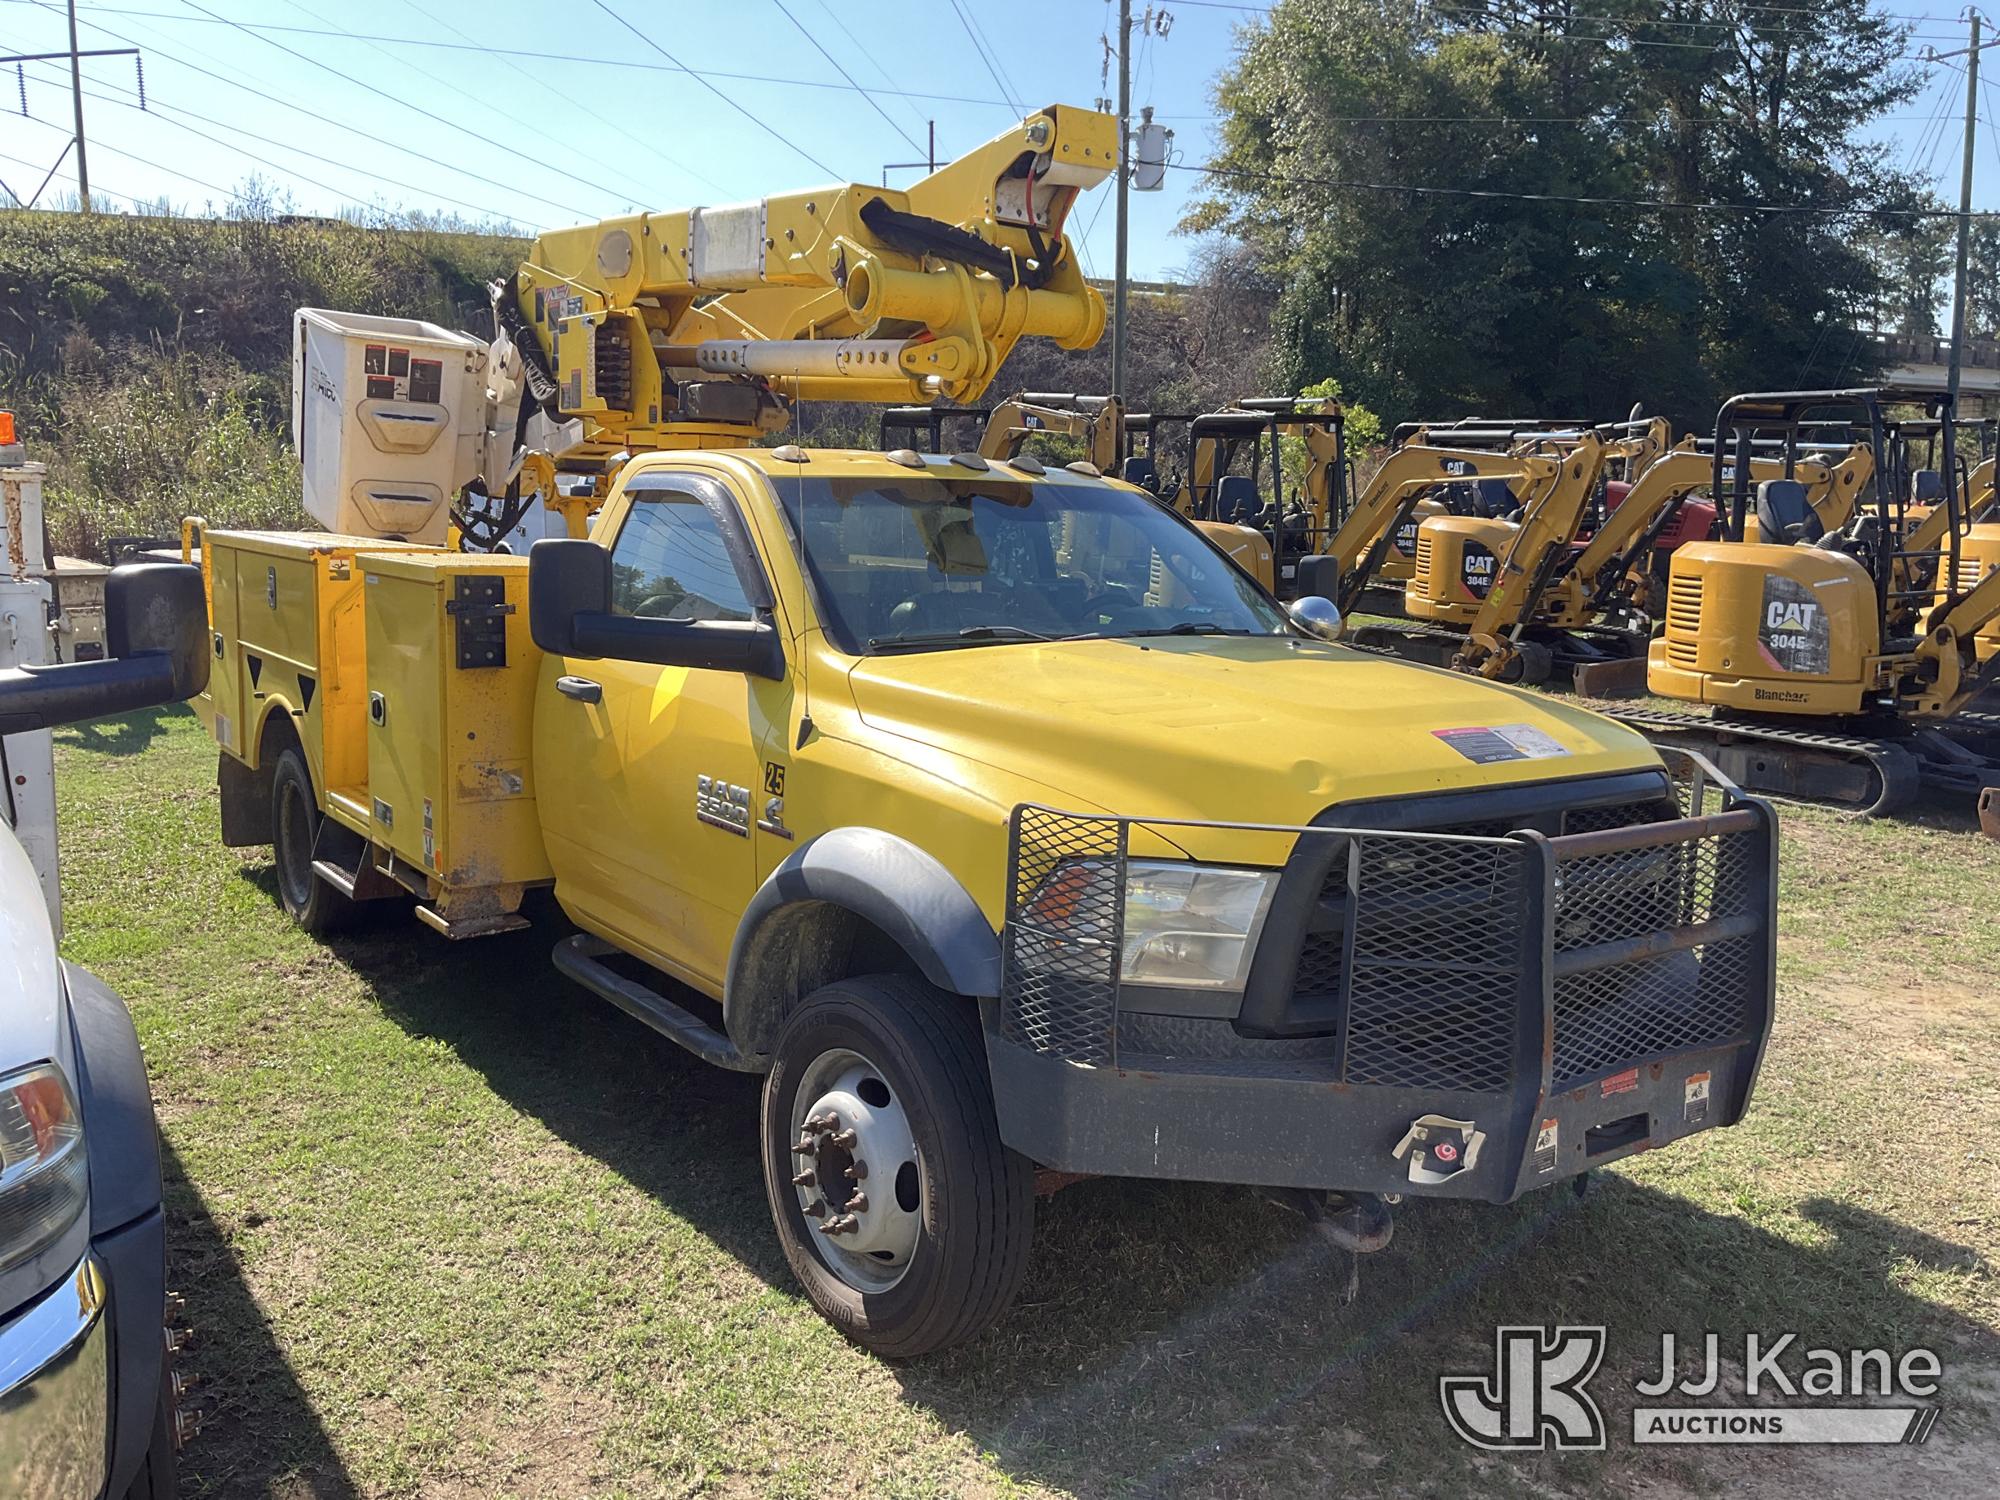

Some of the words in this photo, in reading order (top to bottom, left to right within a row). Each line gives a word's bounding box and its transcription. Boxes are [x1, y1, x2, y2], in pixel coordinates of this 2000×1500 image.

[1447, 461, 1465, 475] CAT
[1721, 466, 1736, 480] CA
[1465, 556, 1494, 574] CAT
[1467, 576, 1488, 586] 304E
[1766, 601, 1817, 632] CAT
[766, 763, 785, 795] 25
[697, 774, 750, 810] RAM
